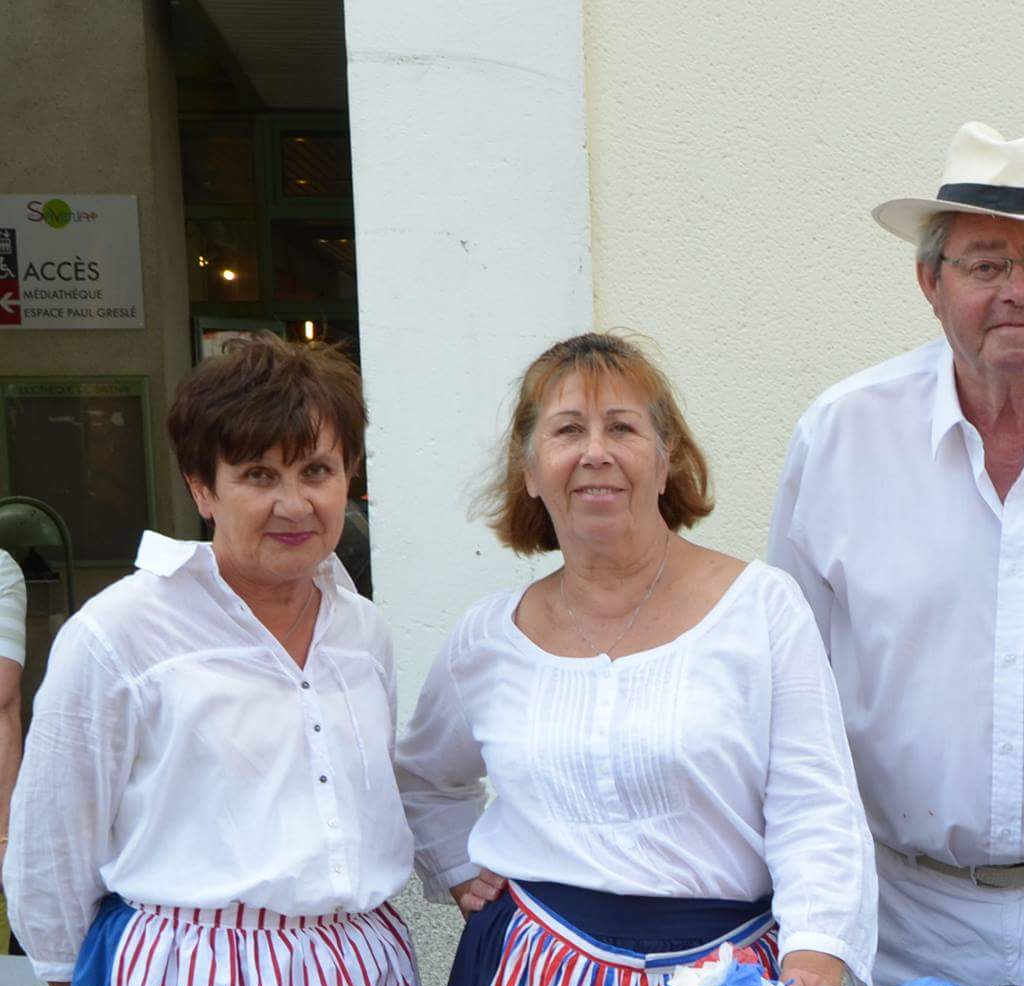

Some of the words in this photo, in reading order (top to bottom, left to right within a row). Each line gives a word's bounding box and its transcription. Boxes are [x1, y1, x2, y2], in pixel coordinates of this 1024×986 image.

[23, 256, 100, 281] ACCÈS
[24, 307, 64, 318] ESPACE
[67, 307, 94, 318] PAUL
